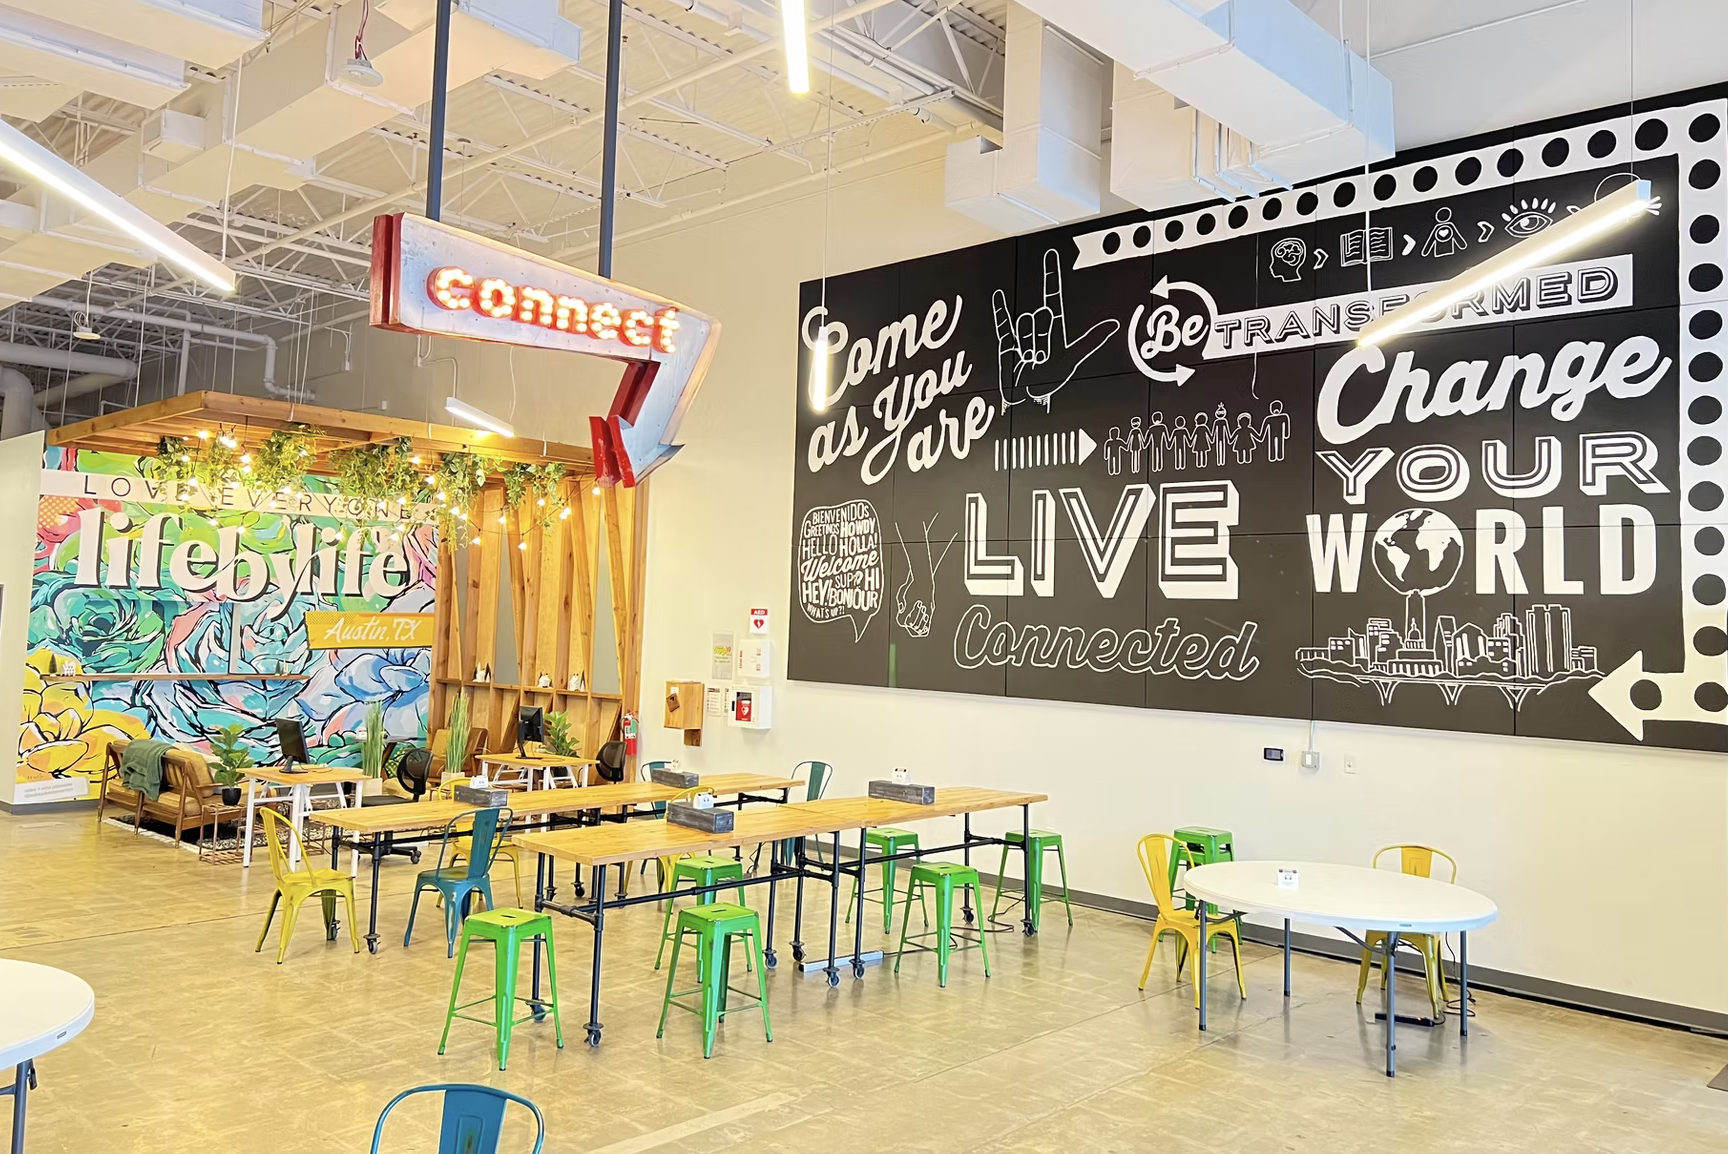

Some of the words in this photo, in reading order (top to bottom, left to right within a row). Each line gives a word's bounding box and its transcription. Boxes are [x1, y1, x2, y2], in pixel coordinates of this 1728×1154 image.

[427, 265, 681, 354] connect
[1141, 304, 1209, 360] Be
[802, 294, 963, 408] Come
[1316, 335, 1673, 445] Change
[807, 405, 870, 473] as
[906, 396, 996, 473] are
[1315, 431, 1671, 505] YOUR
[803, 520, 839, 538] GREETINGS
[840, 517, 876, 538] HOWDY
[812, 502, 870, 524] BIENVENIDOS
[963, 479, 1240, 600] LIVE
[800, 550, 880, 582] Welcome
[802, 534, 838, 560] HELLO
[839, 532, 878, 557] HOLLA!
[801, 579, 832, 606] HEY!
[864, 567, 880, 591] HI
[323, 616, 390, 643] Austin,
[393, 617, 423, 641] TX
[953, 604, 1260, 681] Connected
